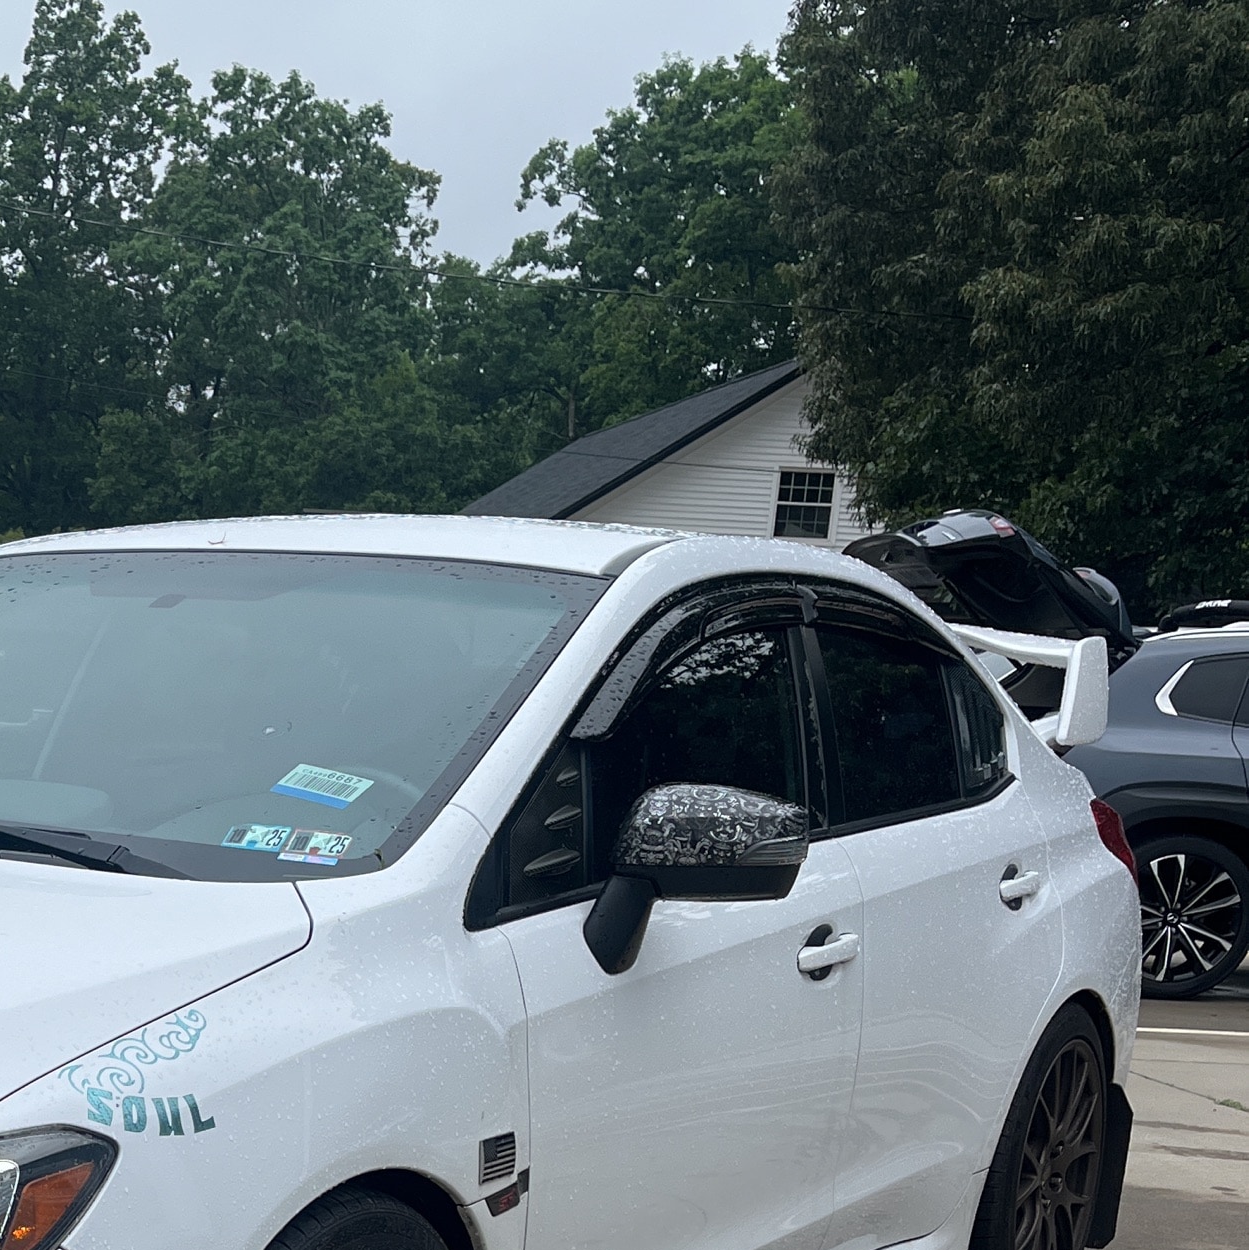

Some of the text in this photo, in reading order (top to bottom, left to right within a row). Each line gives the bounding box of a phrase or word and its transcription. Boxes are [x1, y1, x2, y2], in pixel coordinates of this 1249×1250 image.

[265, 829, 287, 846] 25
[328, 836, 349, 853] 25
[86, 1086, 216, 1136] SOUL
